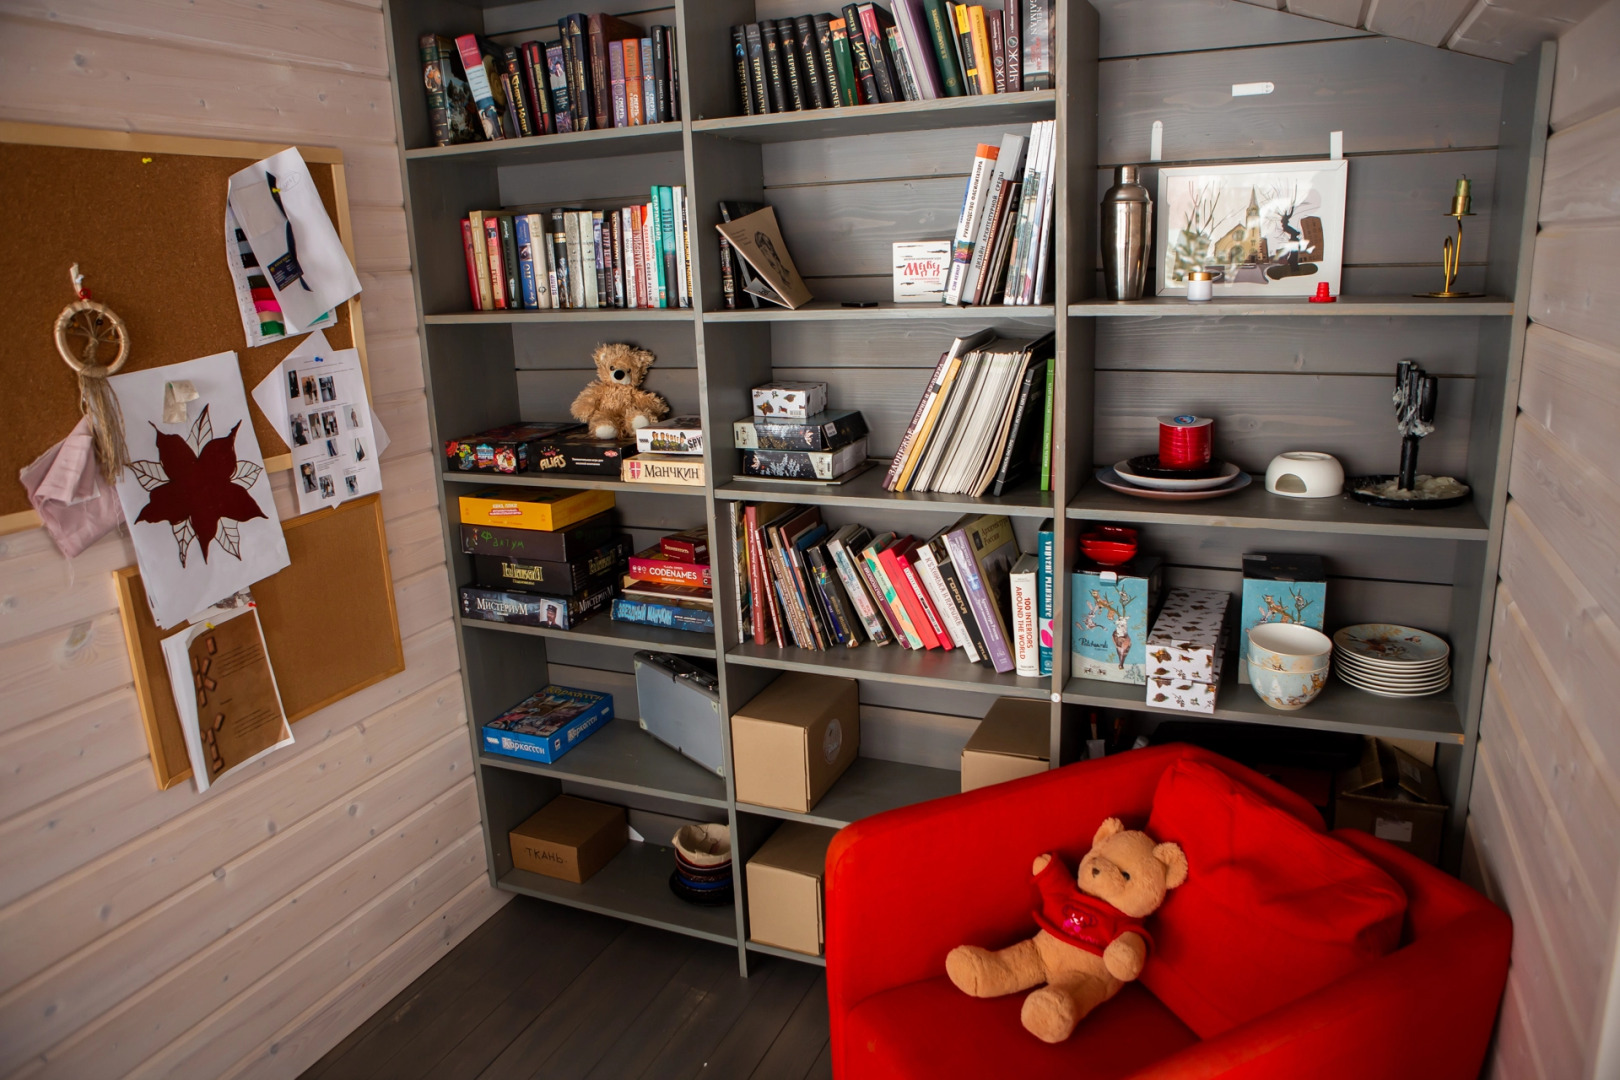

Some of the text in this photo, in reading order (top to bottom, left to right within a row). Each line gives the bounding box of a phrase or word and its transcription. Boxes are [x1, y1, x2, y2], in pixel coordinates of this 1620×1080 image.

[738, 60, 746, 83] ТЕРРИ
[752, 57, 762, 81] ТЕРРИ
[786, 52, 796, 77] ТЕРРИ
[805, 50, 815, 75] ТЕРРИ
[822, 47, 834, 73] ТЕРРИ
[963, 160, 983, 238] РУКОВОДСТВО ФАСИЛИТАТОРА
[651, 194, 661, 240] СТАРТАП-ГАЙД
[975, 170, 1004, 269] ДИЗАЙН АРХИТЕКТУРНОЙ СРЕДЫ
[602, 228, 610, 247] АРТУР
[632, 233, 643, 266] МАВЕРИК
[642, 224, 650, 261] ВДОХНОВЛЯЙ
[1018, 392, 1026, 405] ЦВЕТА
[887, 427, 915, 476] ЗАОНЕЖЬЕ
[911, 399, 927, 424] ИСТОРИЯ
[926, 362, 944, 392] КУЛЬТУРА
[1014, 404, 1023, 423] ИСТОРИЯ
[688, 437, 703, 449] SPY
[1005, 438, 1014, 456] ПАСТУРО
[540, 454, 567, 471] ALIAS
[645, 465, 699, 481] Манчкин
[1001, 455, 1009, 473] МИШЕЛЬ
[984, 532, 1000, 545] России
[649, 567, 697, 580] CODENAMES
[862, 566, 884, 602] КУЛЬТУРОЛОГИЯ
[1042, 540, 1052, 616] ЭЛЕМЕНТЫ ДИЗАЙНА
[477, 597, 528, 615] Мистериум
[579, 585, 614, 614] Мистериум
[978, 597, 1002, 640] Архитектура России
[1015, 586, 1025, 659] AROUND THE WORLD
[1023, 596, 1032, 648] 100 INTERIORS
[501, 737, 545, 755] Каркассон
[525, 848, 564, 863] ТКАНЬ
